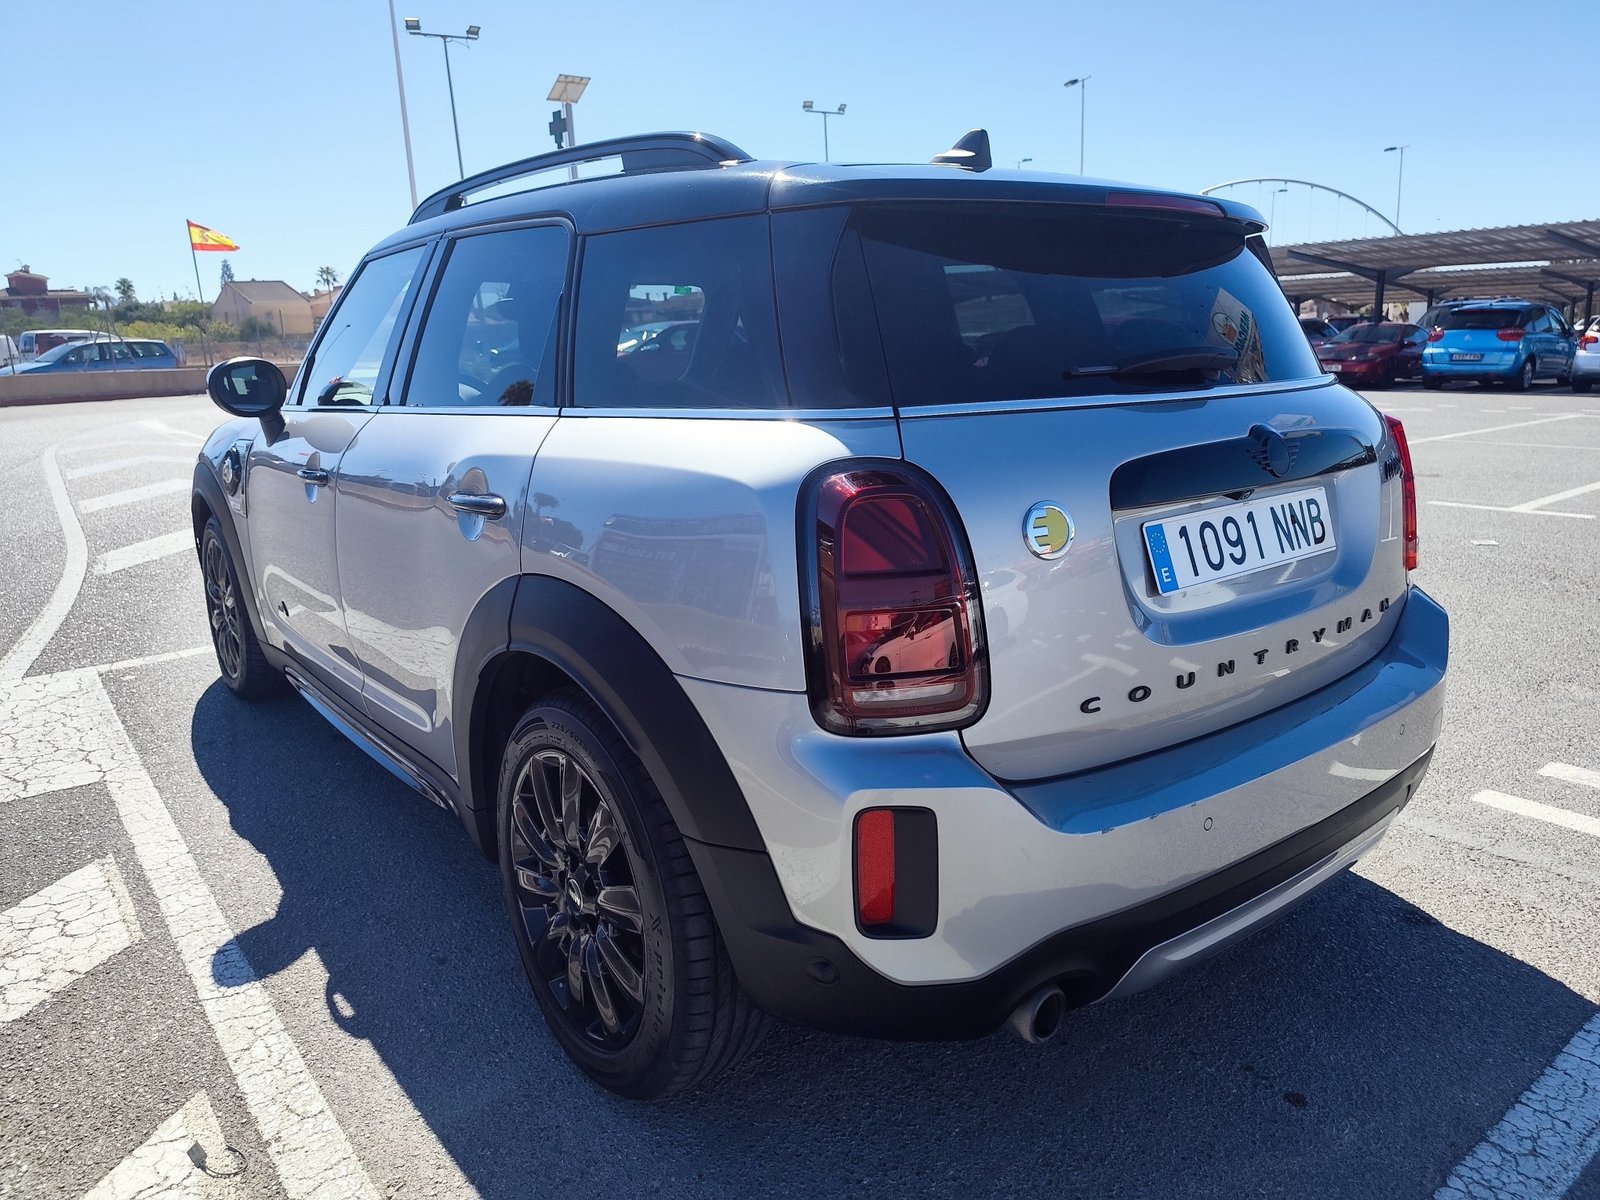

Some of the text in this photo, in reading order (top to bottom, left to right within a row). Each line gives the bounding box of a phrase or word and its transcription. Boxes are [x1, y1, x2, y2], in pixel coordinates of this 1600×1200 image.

[1161, 567, 1172, 583] E
[1179, 497, 1326, 577] 1091 NNB
[1080, 598, 1390, 714] COUNTRYMAN
